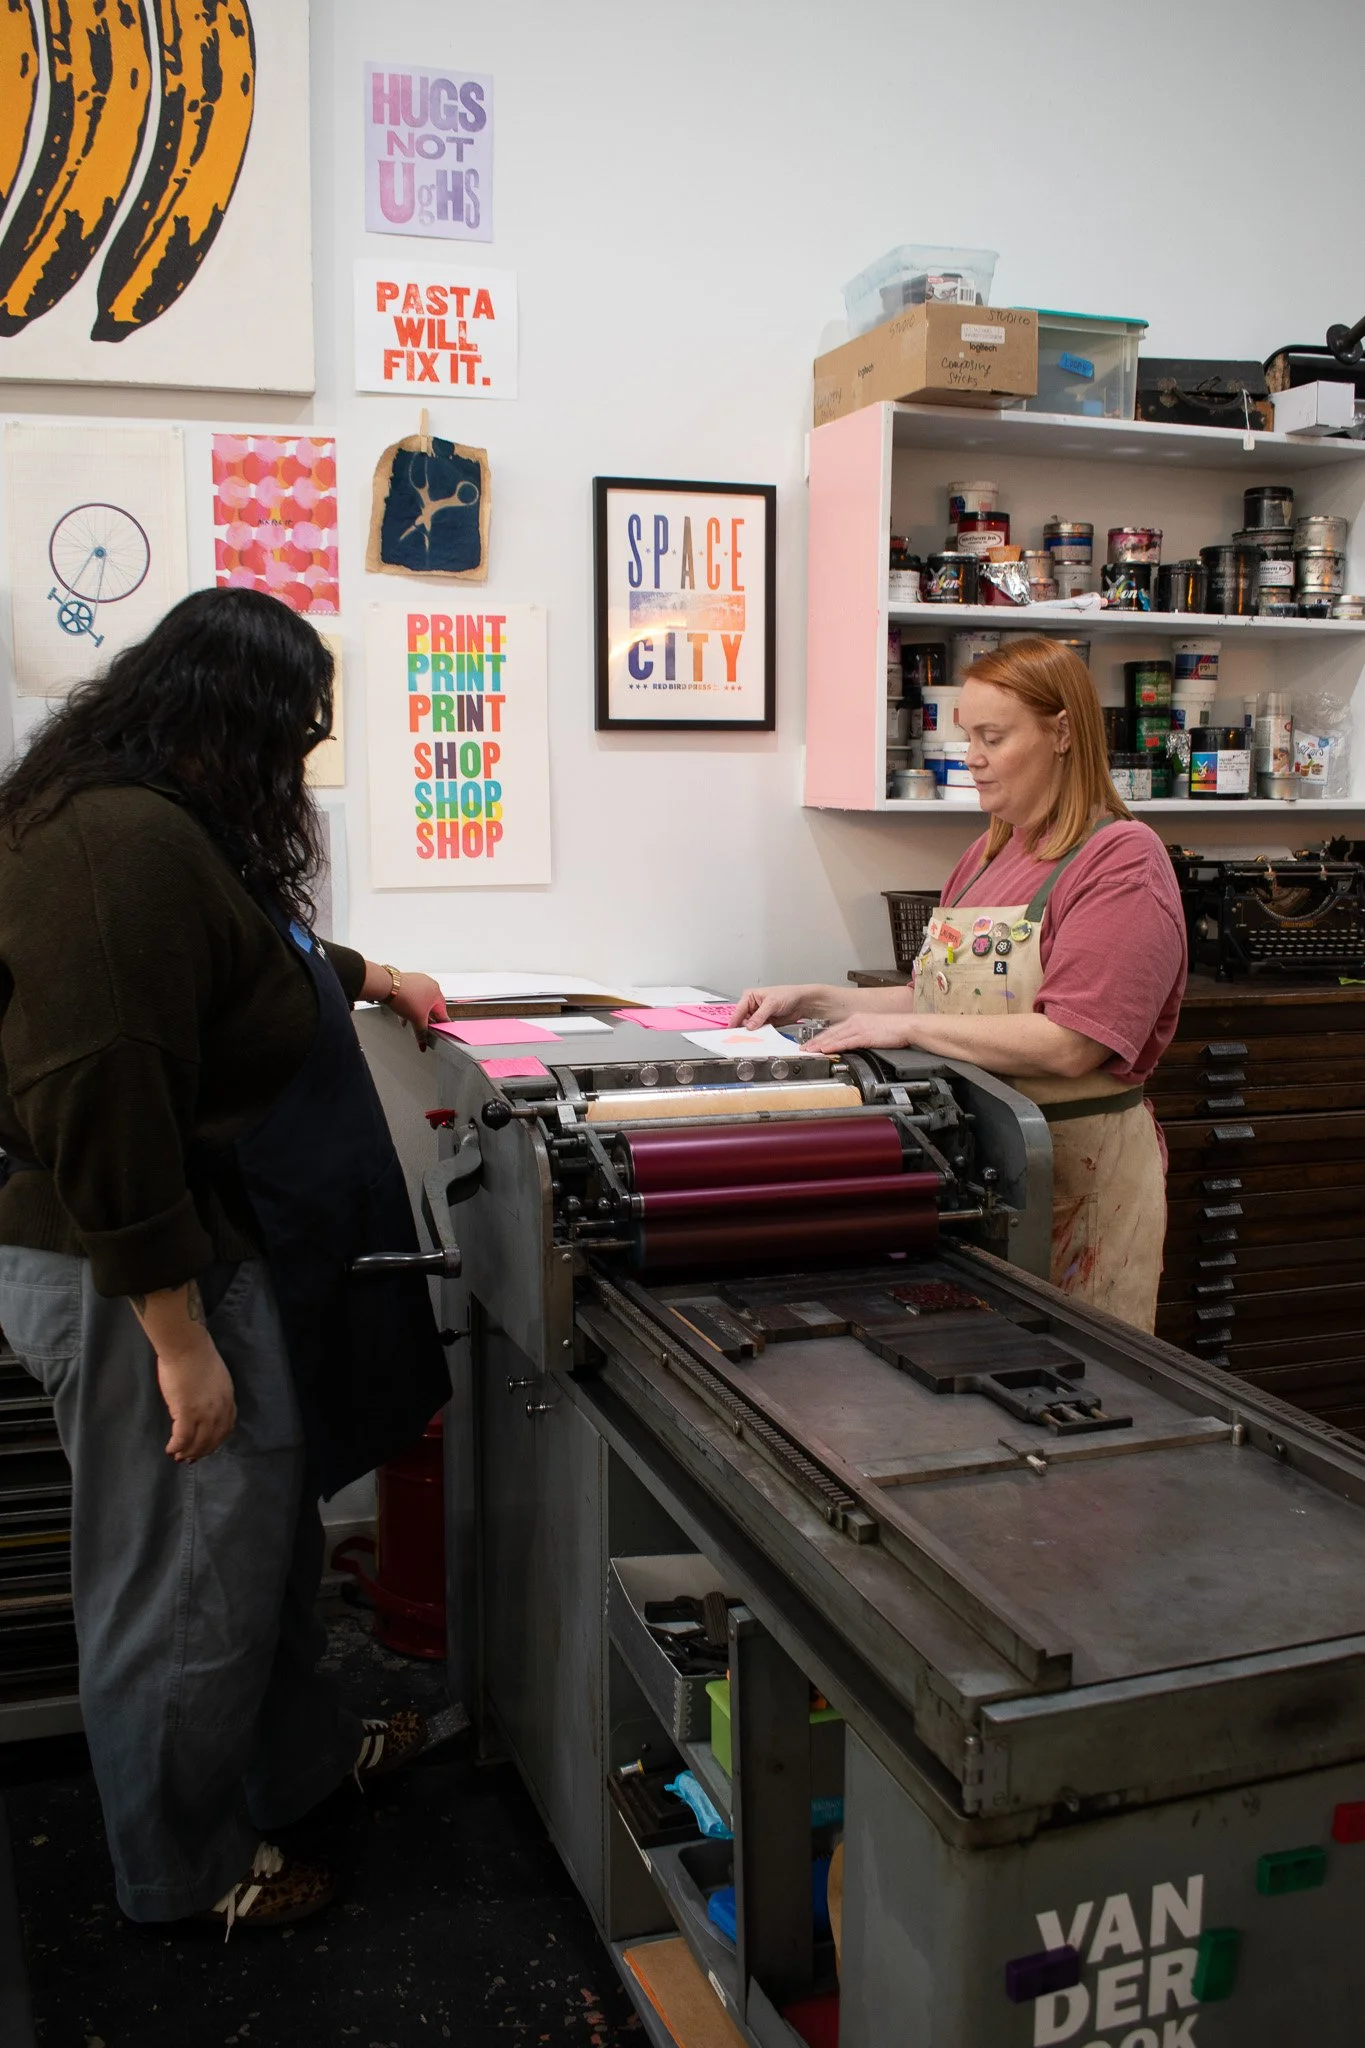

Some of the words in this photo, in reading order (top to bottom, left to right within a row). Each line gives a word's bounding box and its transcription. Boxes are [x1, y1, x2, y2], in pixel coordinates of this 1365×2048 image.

[372, 72, 487, 133] HUGS
[387, 130, 474, 163] NOT
[376, 281, 496, 320] PASTA
[393, 316, 478, 352] WILL
[969, 342, 998, 352] logitech
[383, 349, 440, 383] FIX
[449, 353, 491, 386] IT.
[628, 513, 745, 592] SPACE
[407, 613, 506, 653] PRINT
[407, 653, 506, 692] PRINT
[628, 632, 745, 683] CITY
[668, 683, 687, 691] BIRD
[409, 694, 506, 733] PRINT
[414, 741, 501, 779] SHOP
[415, 780, 503, 819] SHOP
[416, 820, 504, 860] SHOP
[996, 962, 1004, 973] &
[1035, 1874, 1204, 1964] VAN
[1034, 1947, 1201, 2047] DER
